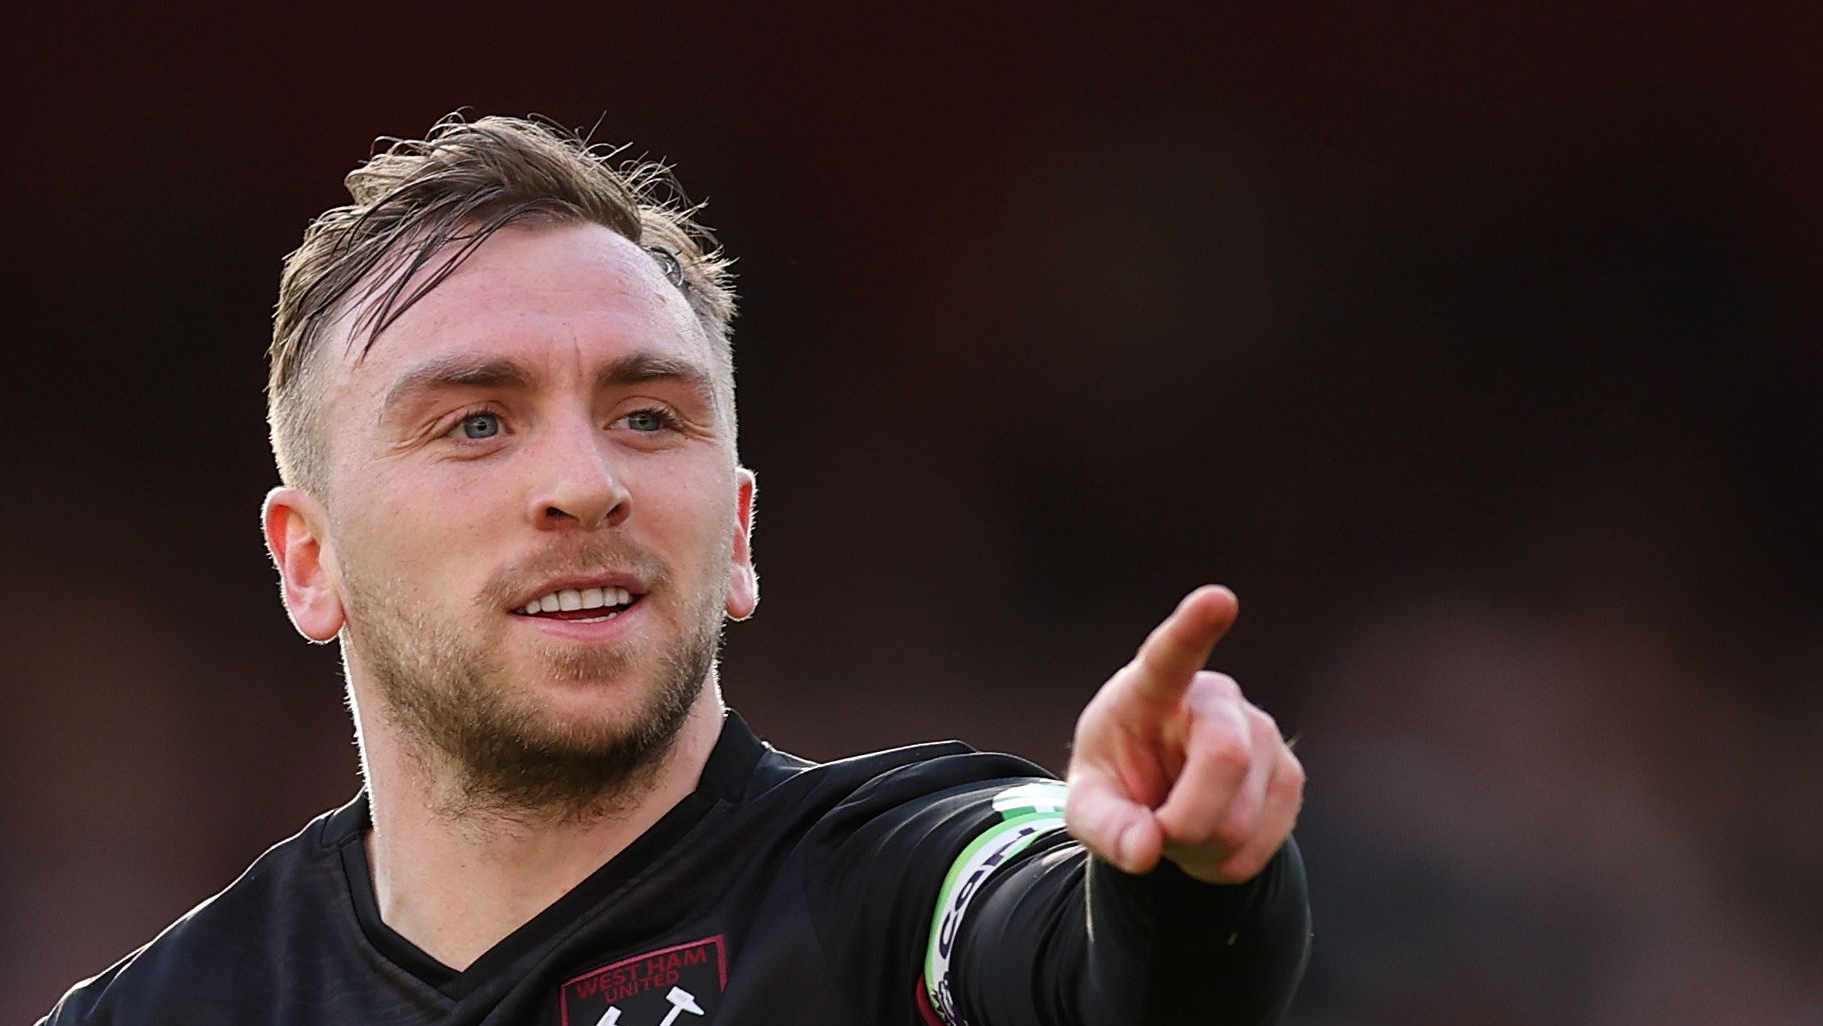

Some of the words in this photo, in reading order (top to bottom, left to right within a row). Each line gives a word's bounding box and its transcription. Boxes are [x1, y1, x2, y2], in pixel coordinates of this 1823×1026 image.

[577, 963, 640, 998] WEST
[648, 947, 707, 974] HAM
[605, 969, 679, 1003] UNITED
